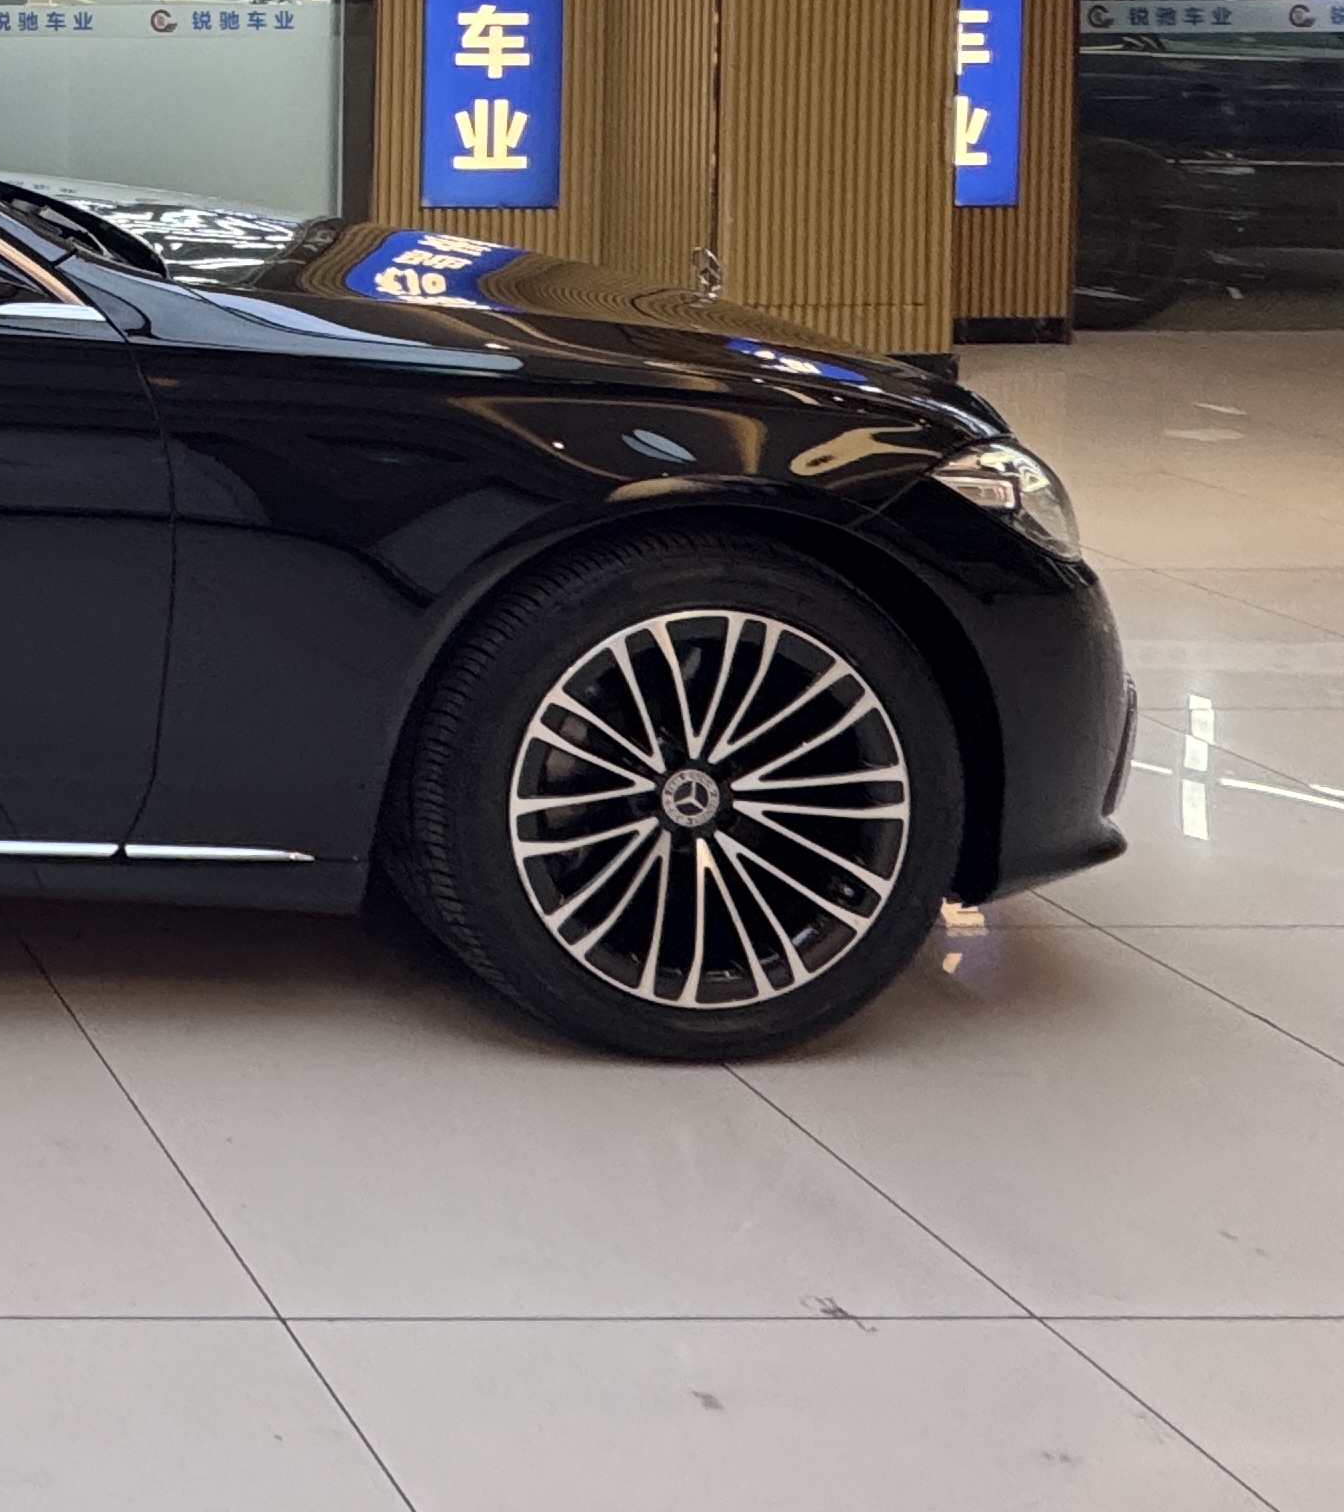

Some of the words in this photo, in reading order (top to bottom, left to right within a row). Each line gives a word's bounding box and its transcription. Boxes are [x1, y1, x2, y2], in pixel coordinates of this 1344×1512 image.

[191, 9, 296, 31] 锐驰车业
[1128, 5, 1233, 26] 锐驰车业
